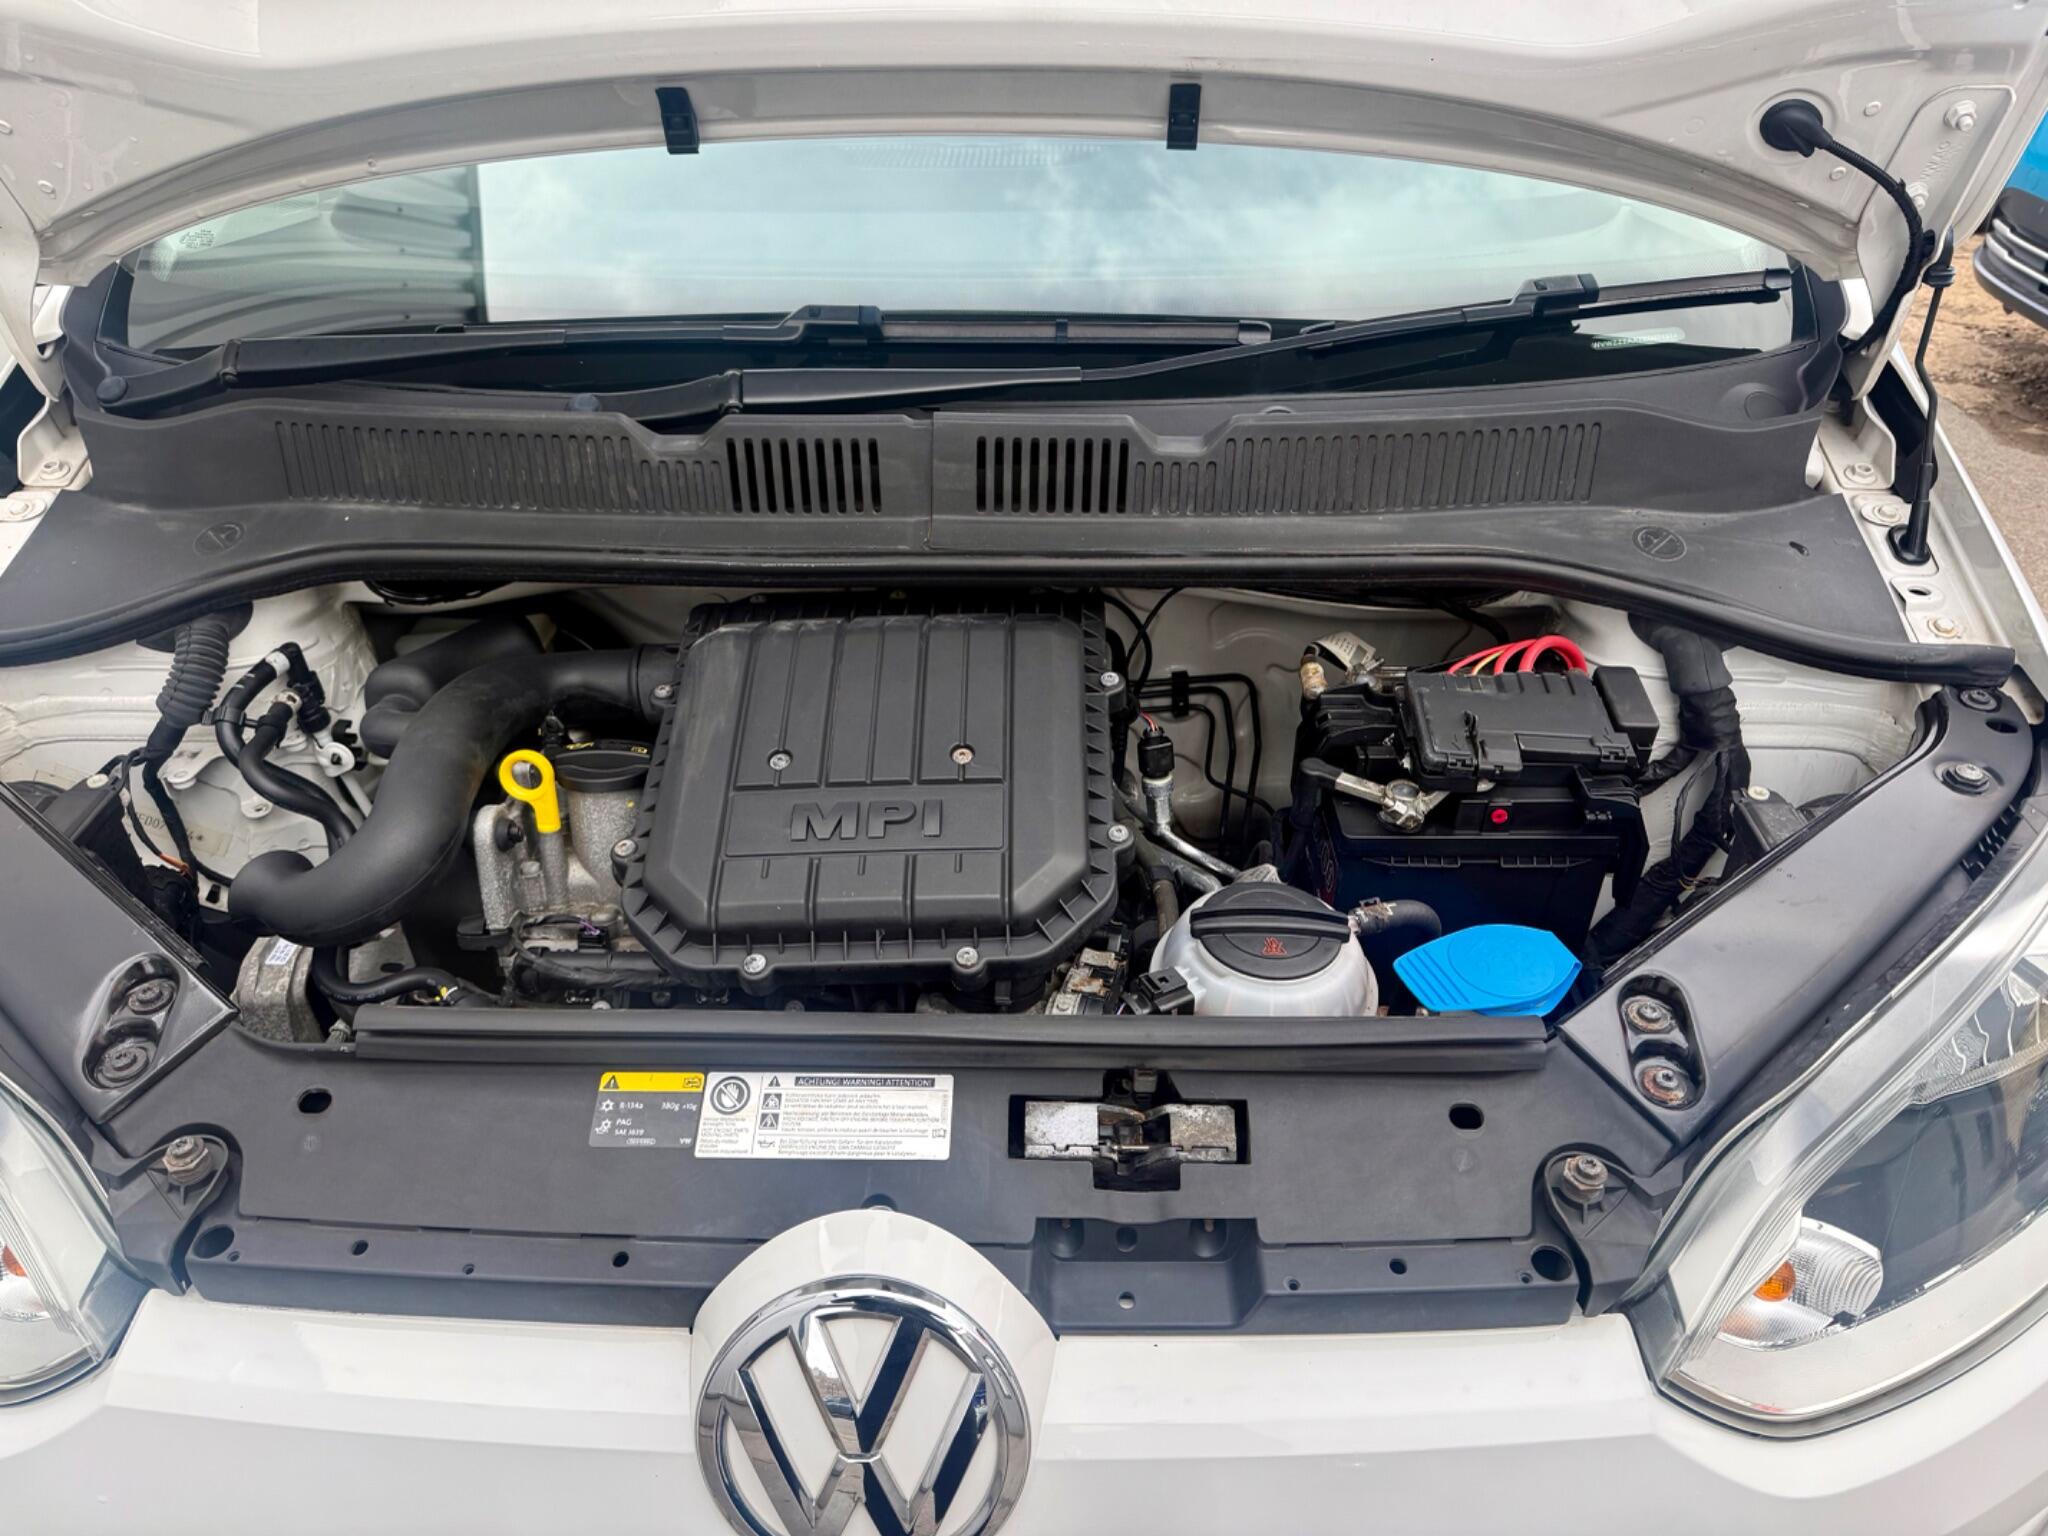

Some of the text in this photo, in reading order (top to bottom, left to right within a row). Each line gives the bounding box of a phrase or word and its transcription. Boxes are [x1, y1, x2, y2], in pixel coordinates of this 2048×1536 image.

[790, 799, 943, 842] MPI
[842, 1078, 884, 1087] WARNING!
[885, 1078, 932, 1088] ATTENTION!
[616, 1118, 633, 1126] PAG
